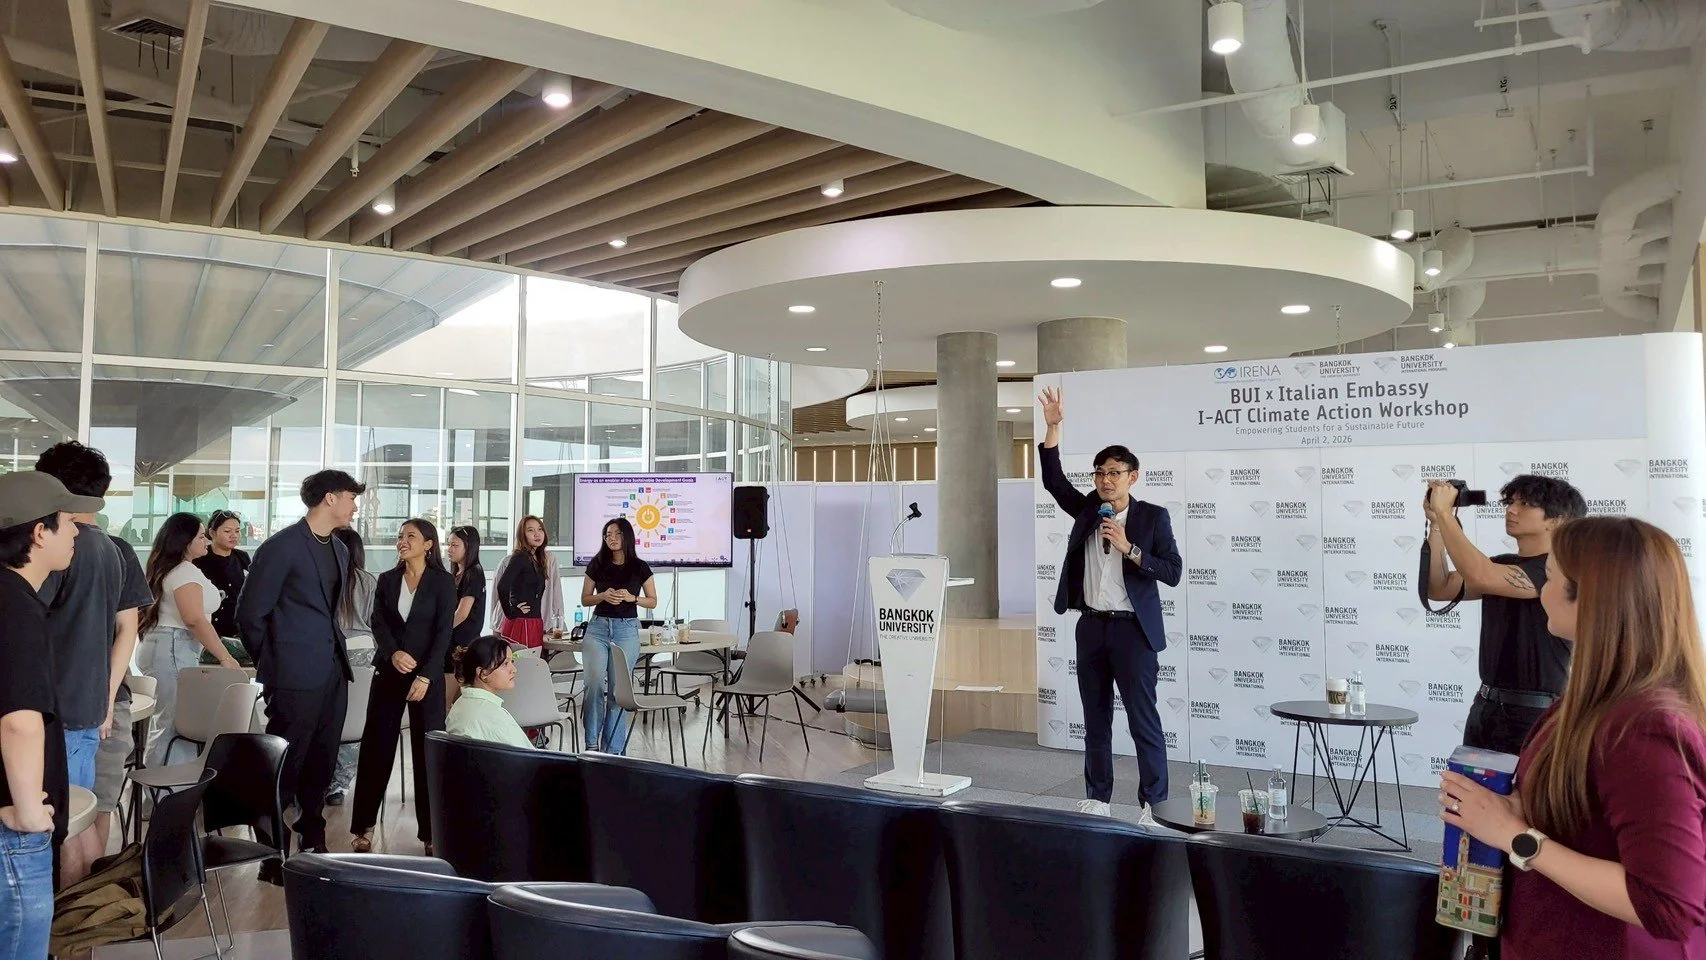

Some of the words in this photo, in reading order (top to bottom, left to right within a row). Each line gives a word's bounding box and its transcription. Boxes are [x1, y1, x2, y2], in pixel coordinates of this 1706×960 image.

[1401, 354, 1434, 362] BANGKOK
[1401, 361, 1443, 369] UNIVERSITY
[1240, 365, 1281, 377] IRENA
[1231, 387, 1259, 404] BUI
[1266, 390, 1274, 399] x
[1279, 384, 1338, 401] Italian
[1347, 381, 1429, 398] Embassy
[1199, 408, 1240, 425] I-ACT
[1248, 406, 1309, 422] Climate
[1317, 403, 1372, 420] Action
[1379, 400, 1469, 418] Workshop
[1236, 426, 1282, 435] Empowering
[1285, 424, 1318, 433] Students
[1345, 421, 1394, 430] Sustainable
[1301, 436, 1320, 445] April
[1322, 436, 1329, 444] 2,
[1332, 435, 1352, 443] 2026
[880, 608, 934, 622] BANGKOK
[880, 621, 934, 633] UNIVERSITY
[1376, 644, 1409, 652] BANGKOK
[1428, 683, 1463, 691] BANGKOK
[1428, 690, 1463, 698] UNIVERSITY
[1191, 701, 1219, 709] BANGKOK
[1236, 739, 1265, 747] BANGKOK
